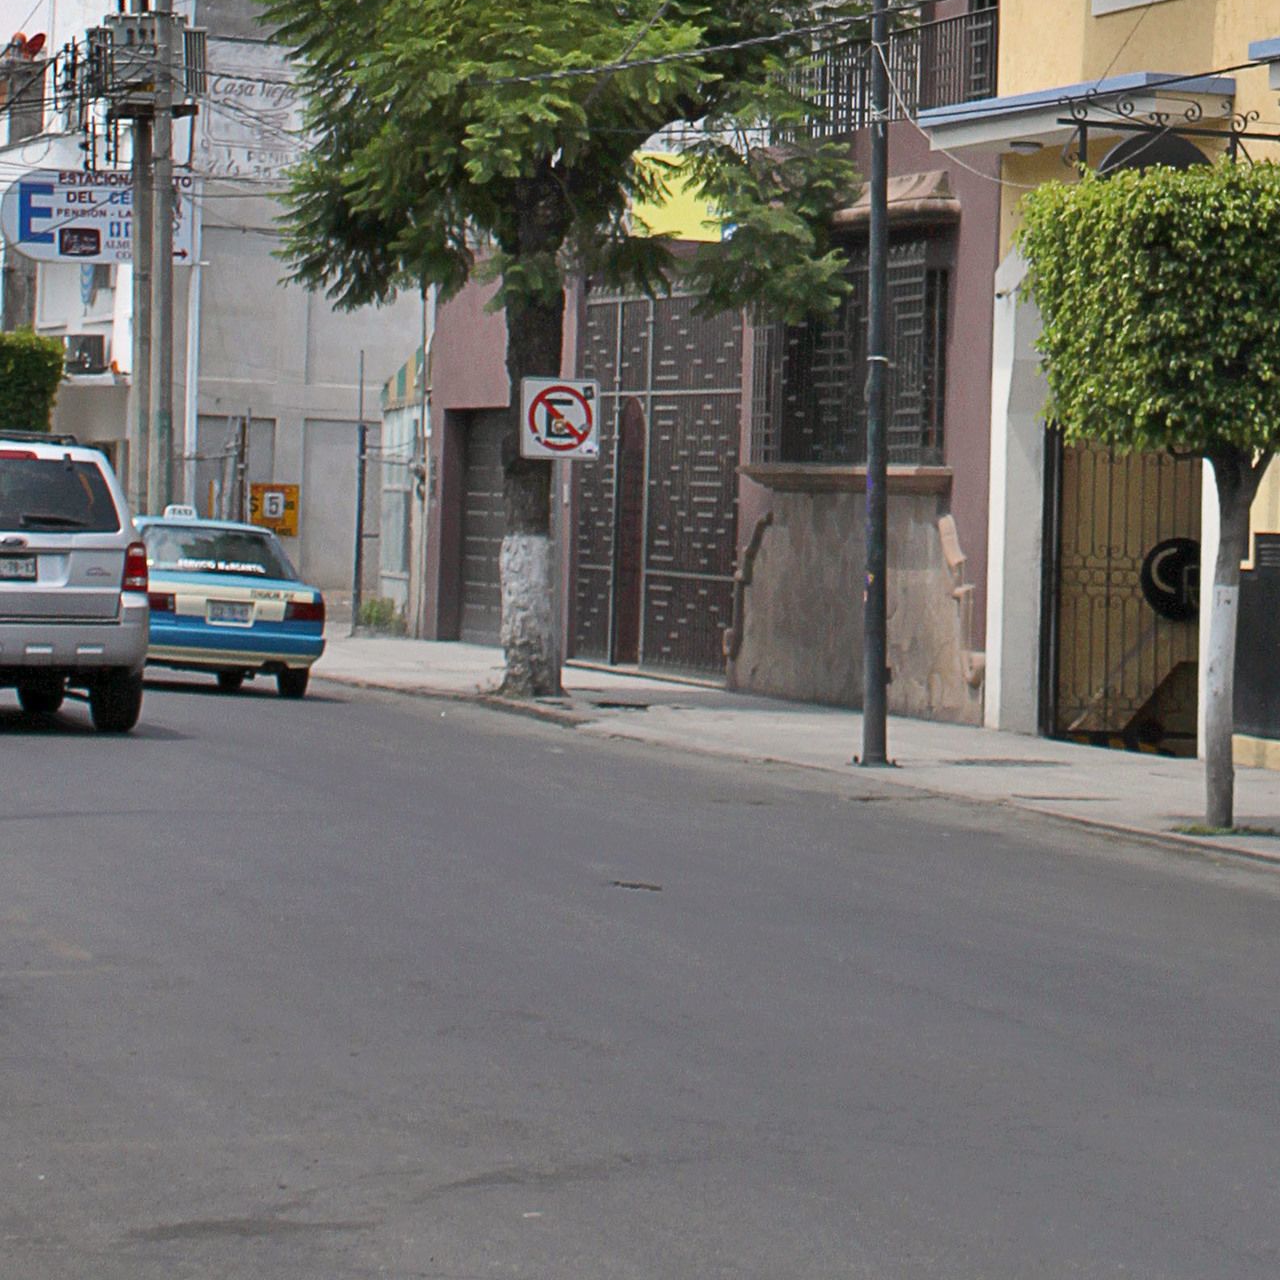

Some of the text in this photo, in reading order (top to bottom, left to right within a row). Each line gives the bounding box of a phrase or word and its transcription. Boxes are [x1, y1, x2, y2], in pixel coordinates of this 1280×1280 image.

[212, 76, 255, 97] Casa
[66, 191, 97, 204] DEL
[19, 182, 54, 244] E
[171, 507, 193, 517] TAXI
